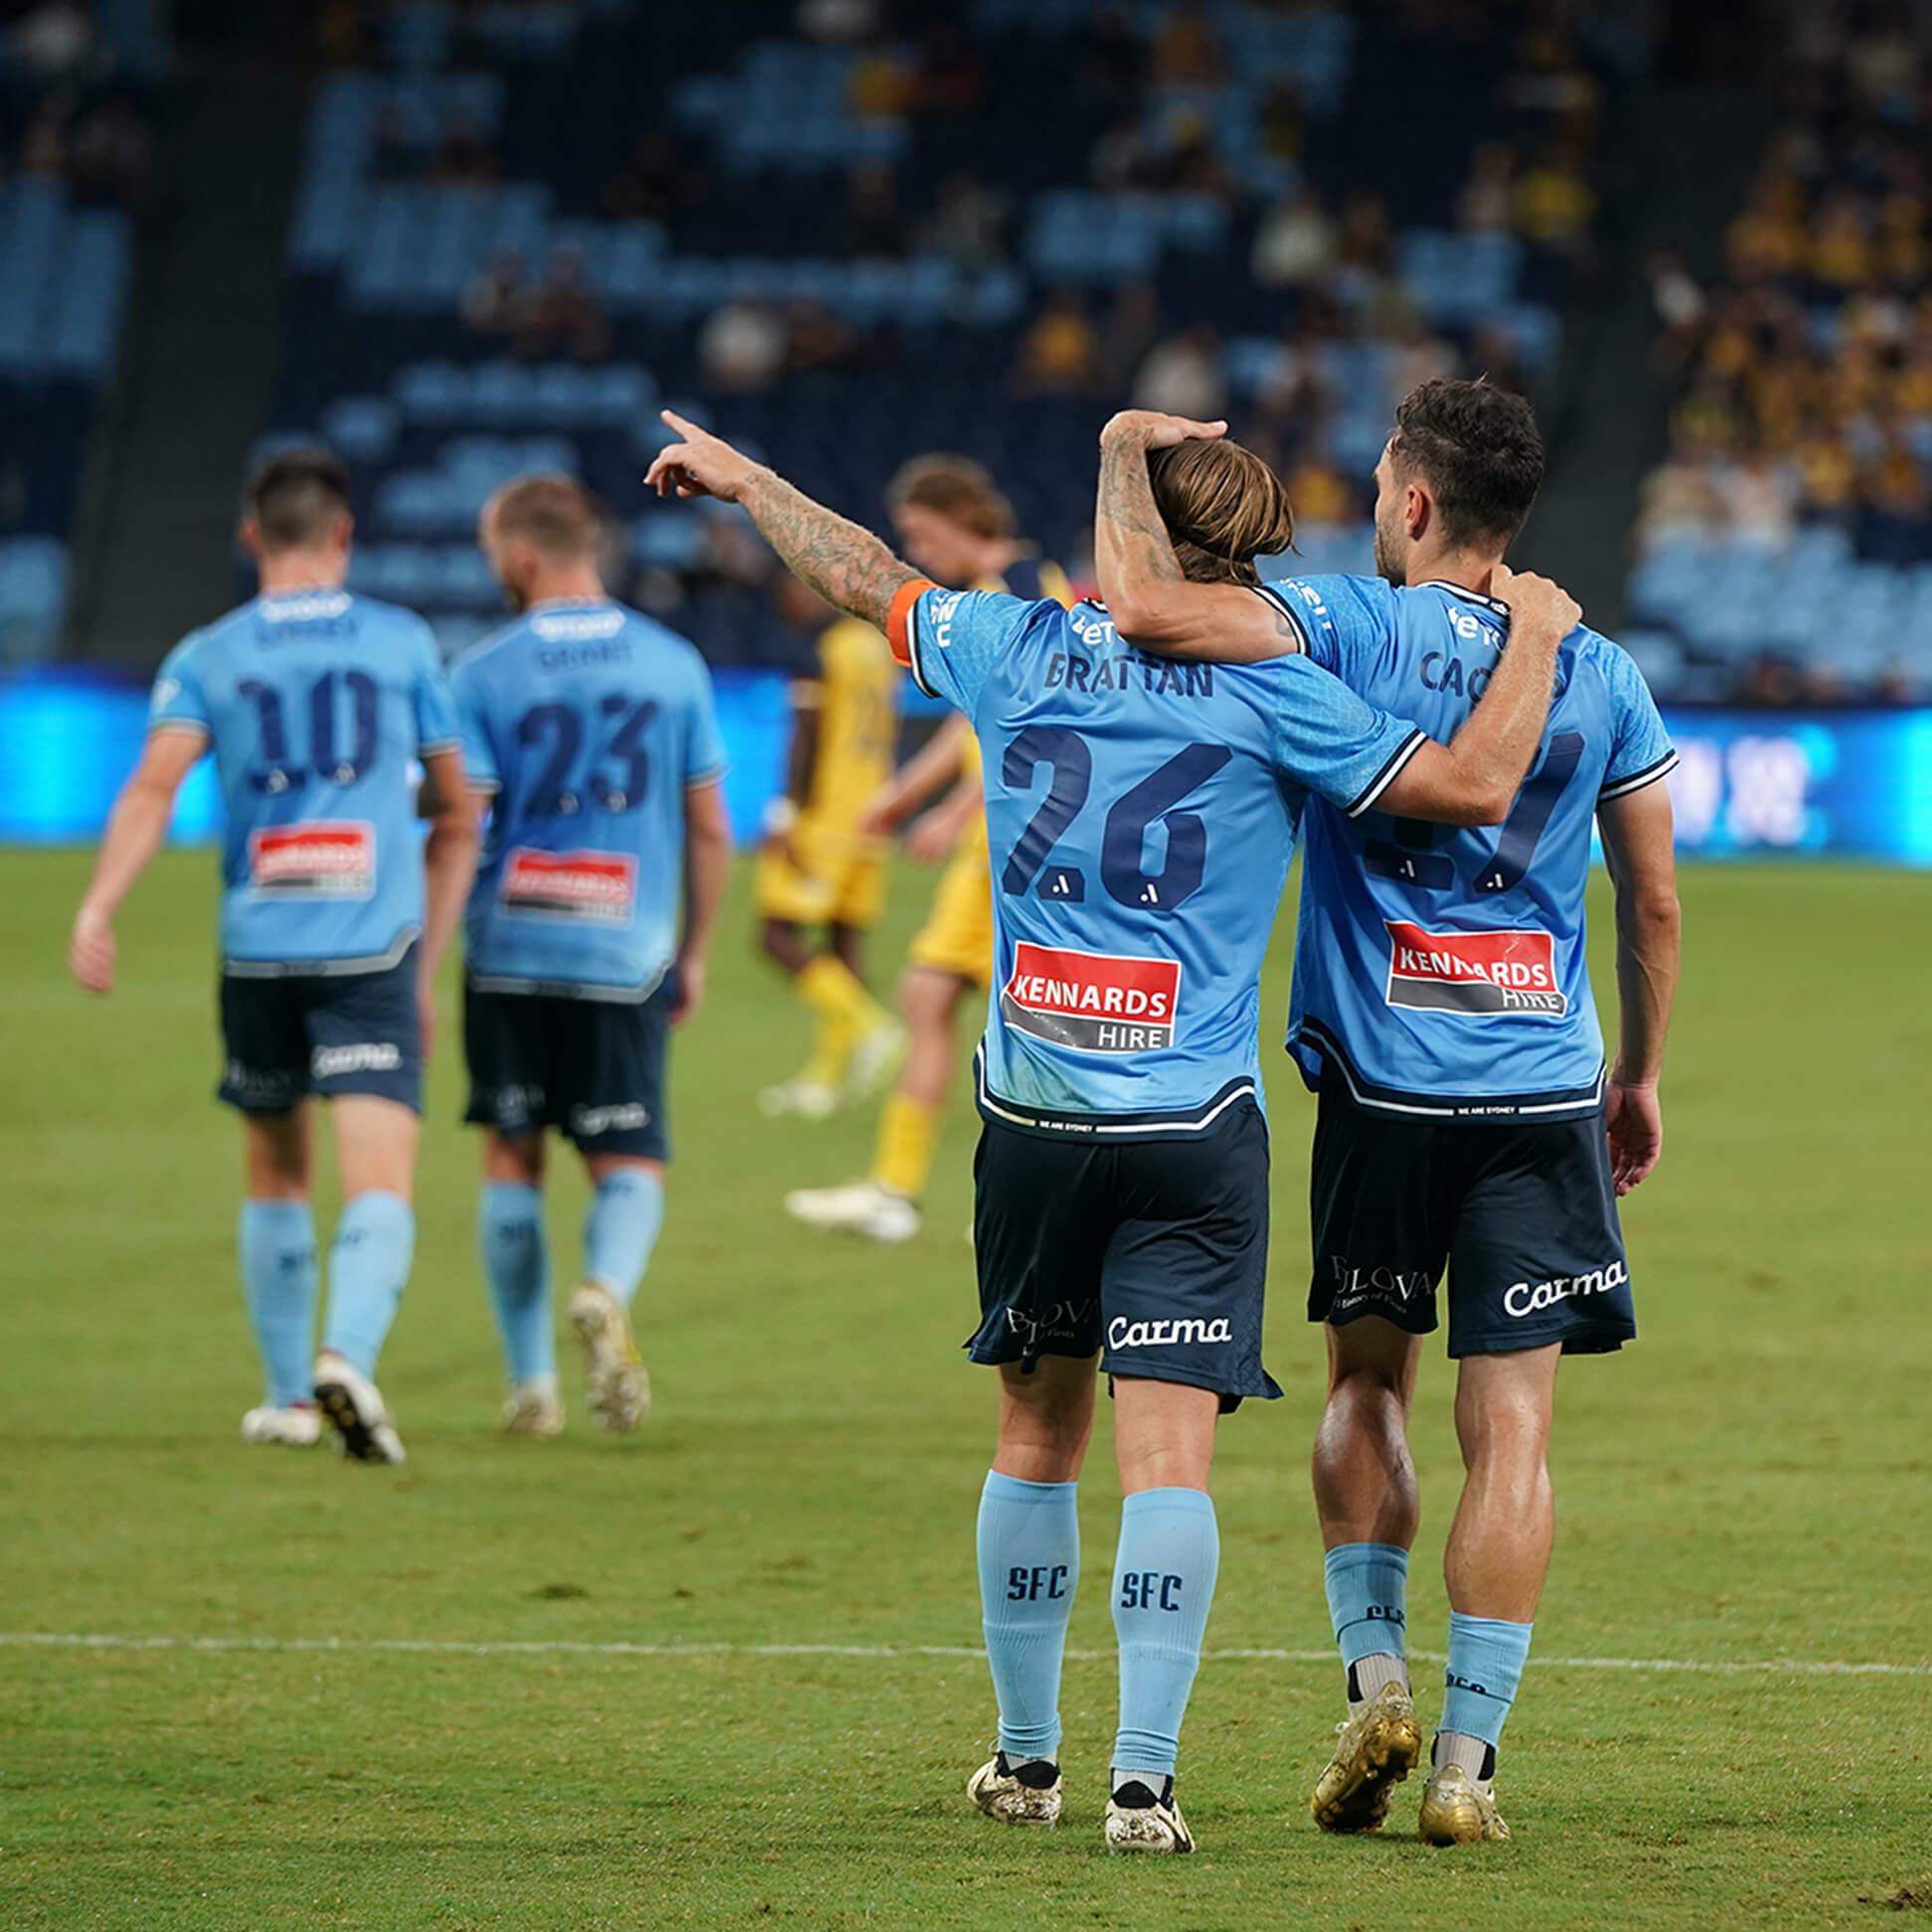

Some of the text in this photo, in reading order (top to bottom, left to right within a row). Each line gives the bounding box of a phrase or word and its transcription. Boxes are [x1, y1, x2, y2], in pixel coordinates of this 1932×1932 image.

[1044, 652, 1213, 697] BRATTAN
[238, 670, 379, 791] 10
[518, 694, 659, 821] 23
[1002, 724, 1233, 912] 26
[1399, 946, 1548, 987] KENNARDS
[1014, 975, 1168, 1018] KENNARDS
[1097, 1025, 1164, 1049] HIRE
[1504, 1259, 1628, 1318] Carma
[1107, 1316, 1232, 1351] Carma
[1007, 1564, 1069, 1601] SFC
[1120, 1571, 1183, 1612] SFC
